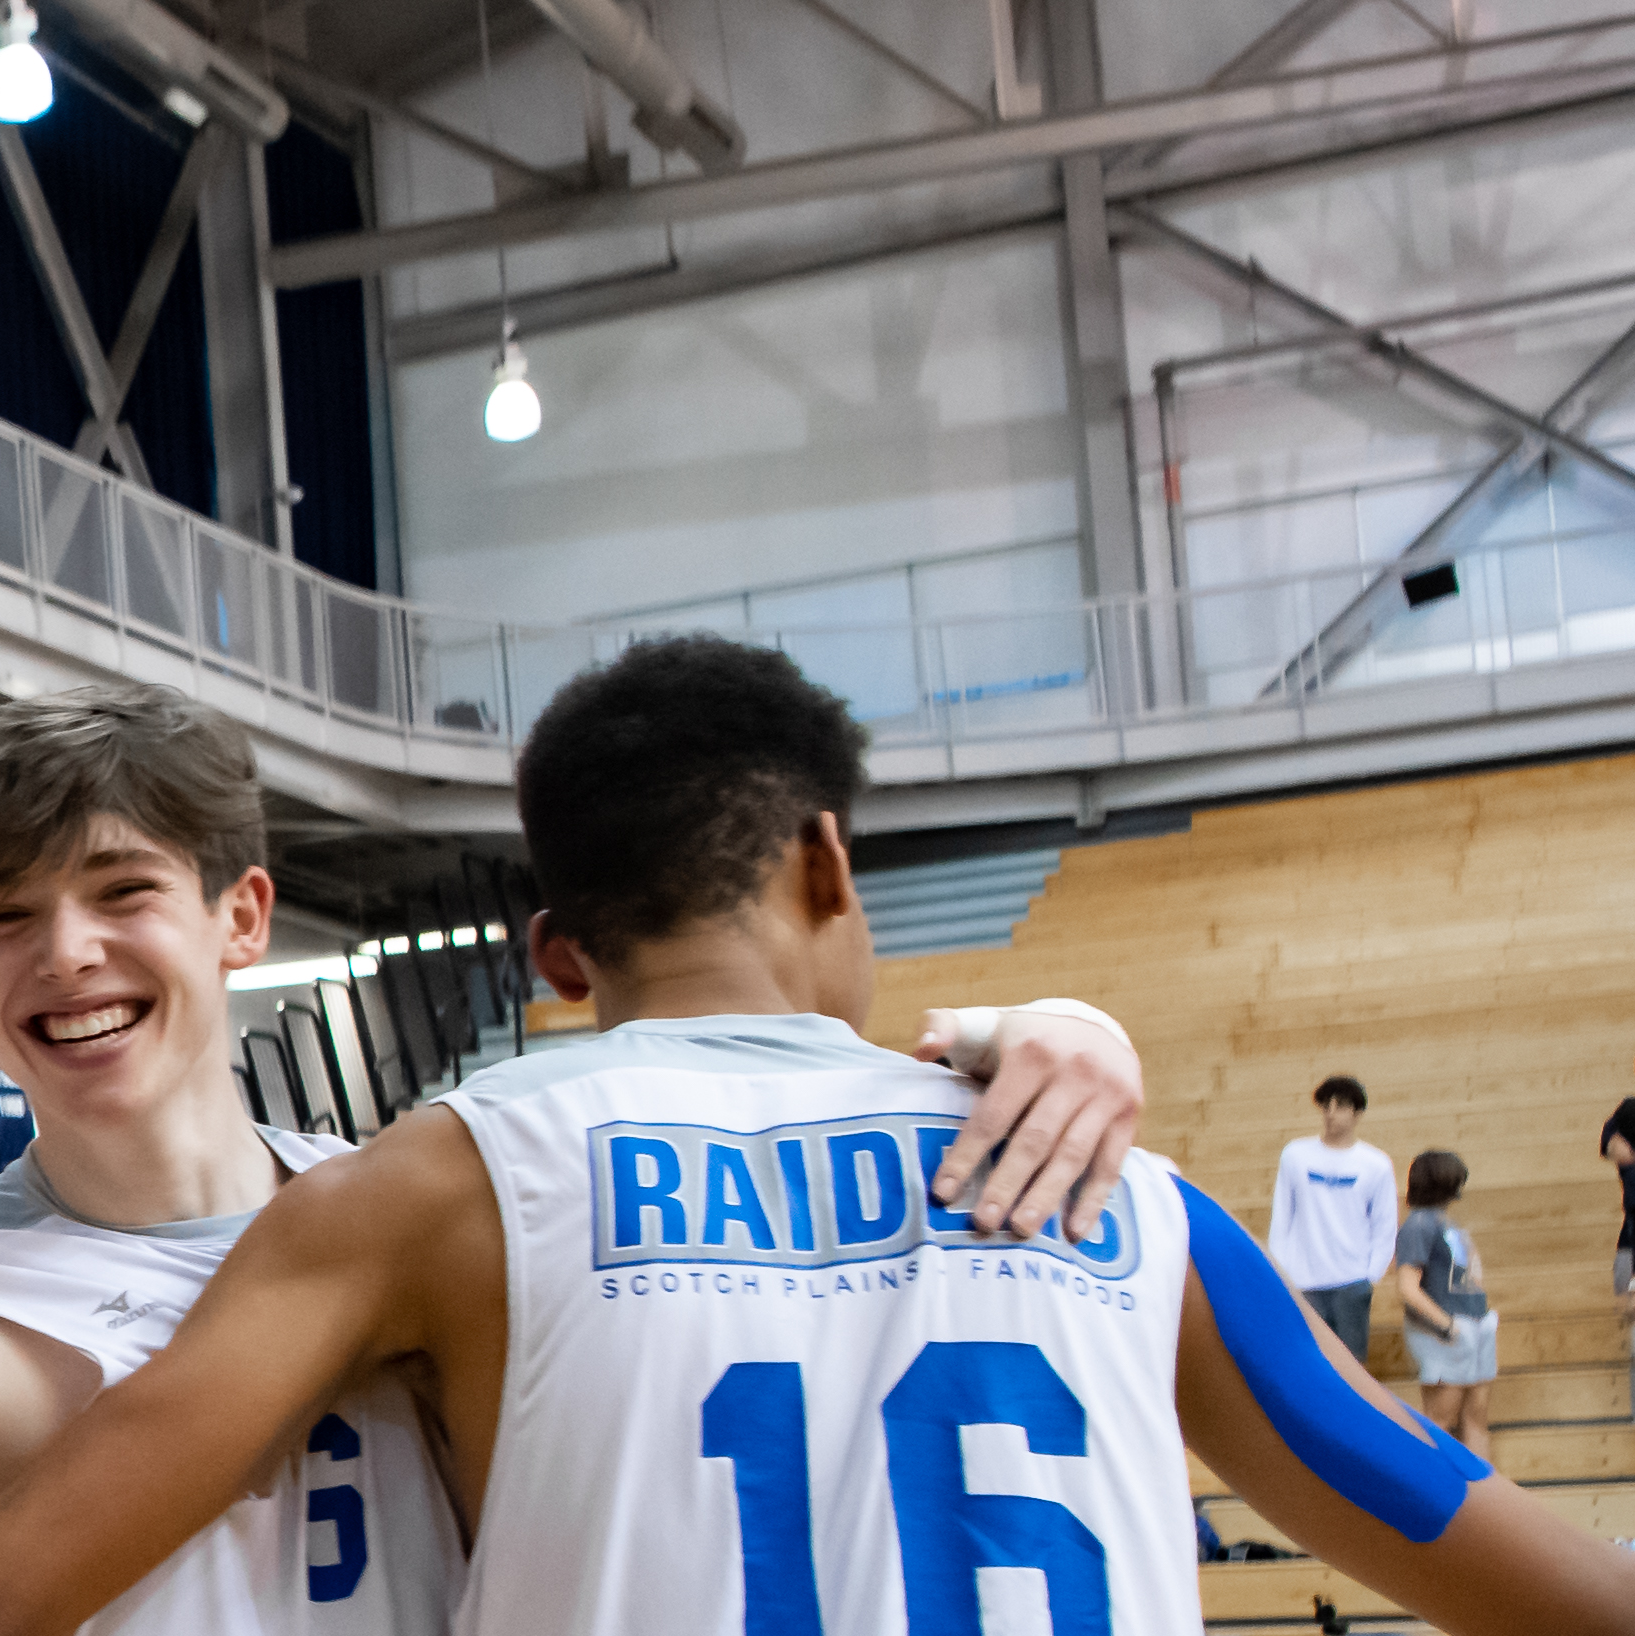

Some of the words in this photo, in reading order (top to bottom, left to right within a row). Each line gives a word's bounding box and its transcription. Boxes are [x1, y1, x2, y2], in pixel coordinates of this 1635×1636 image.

[601, 1269, 761, 1301] SCOTCH
[783, 1261, 921, 1299] PLAINS
[969, 1258, 1138, 1312] FANWOOD
